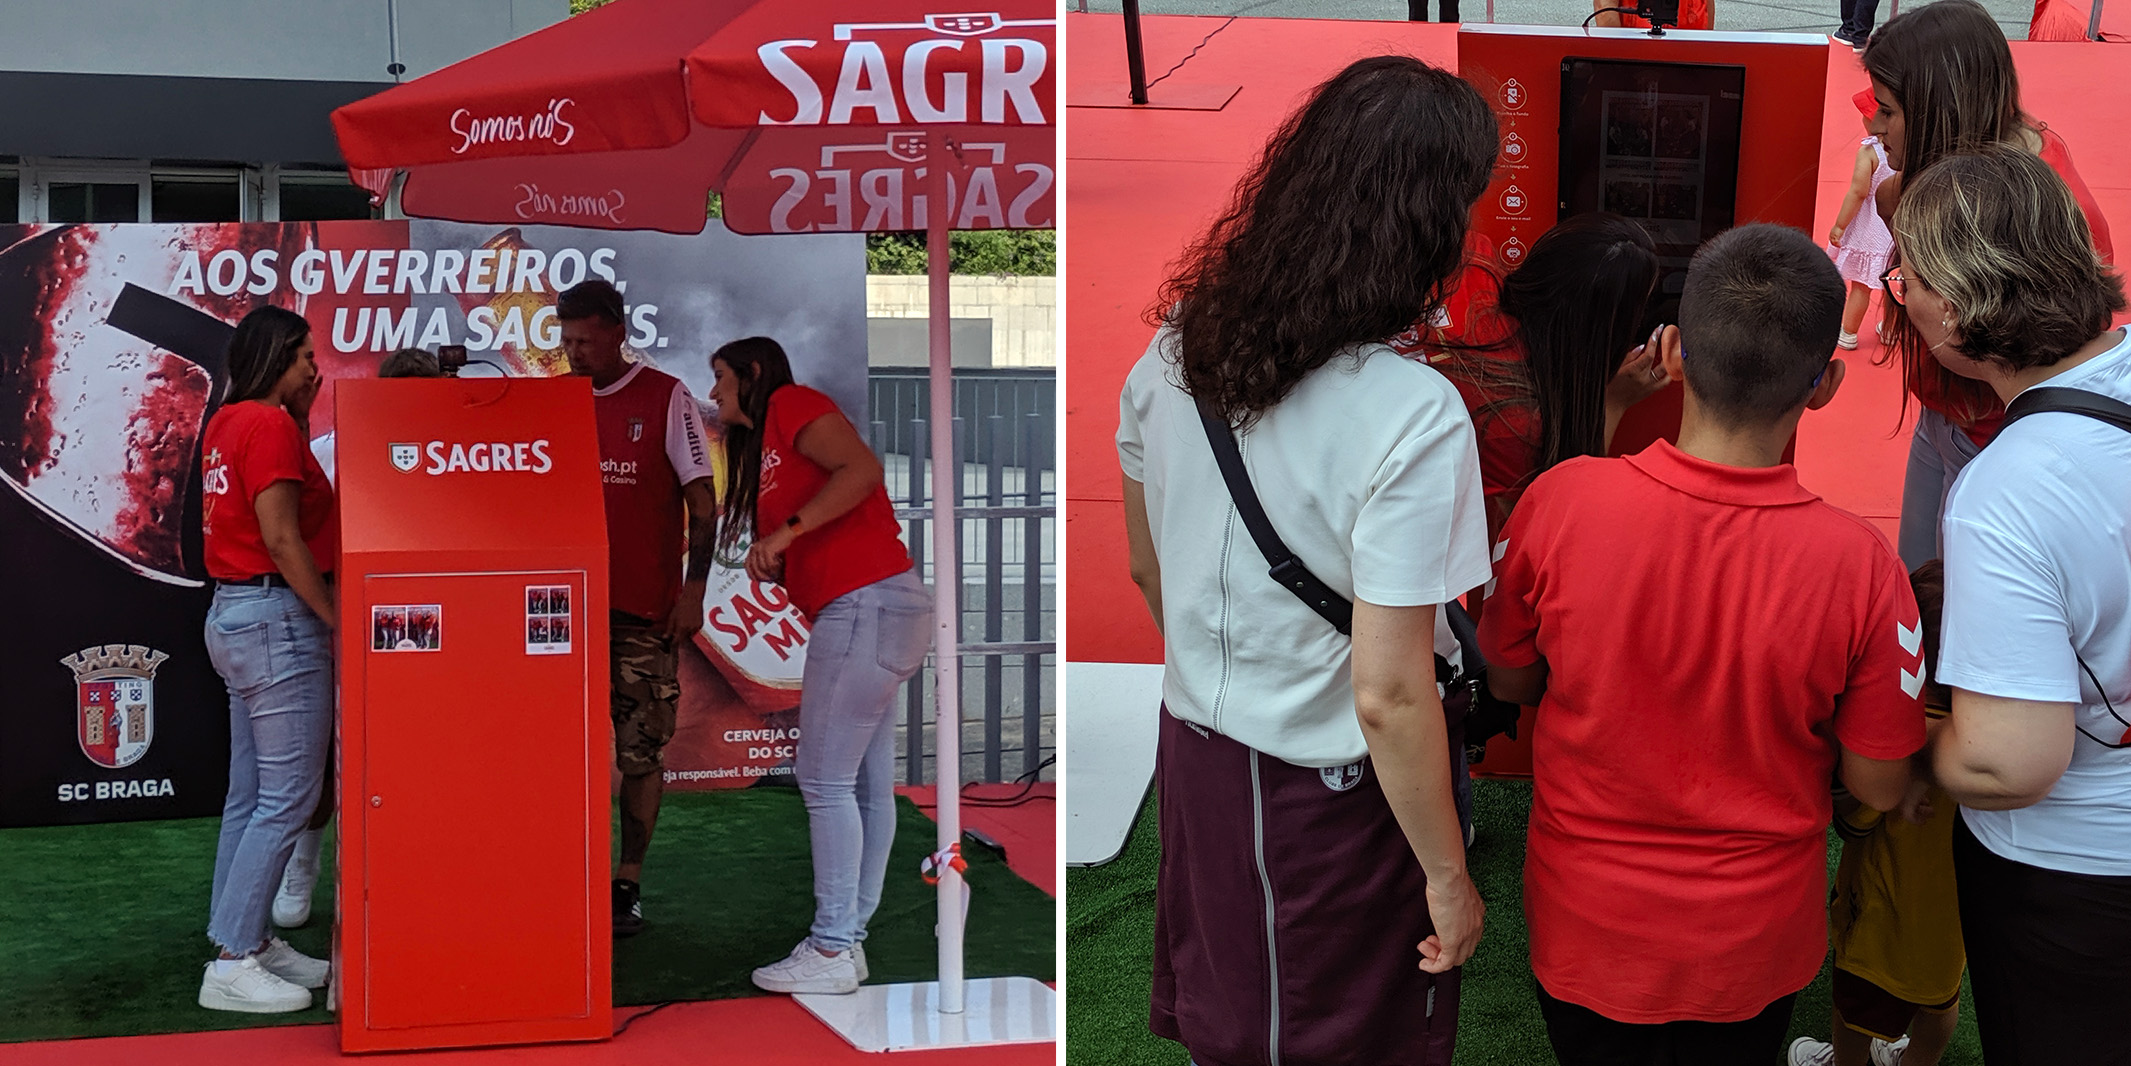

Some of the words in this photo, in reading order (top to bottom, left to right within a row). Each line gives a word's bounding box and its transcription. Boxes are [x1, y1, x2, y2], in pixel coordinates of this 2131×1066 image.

[757, 39, 1047, 125] SAGR
[450, 108, 525, 154] Somos
[166, 249, 279, 296] AOS
[331, 307, 451, 353] UMA
[464, 303, 669, 351] SAGS.
[426, 439, 552, 476] SAGRES
[600, 458, 638, 475] sh.pt
[610, 475, 637, 485] Casino
[708, 580, 789, 653] SAG
[723, 729, 786, 744] CERVEJA
[748, 746, 772, 759] DO
[774, 745, 793, 758] SC
[679, 766, 741, 782] responsável.
[743, 765, 768, 778] Beba
[769, 766, 791, 776] com
[58, 783, 90, 802] SC
[95, 778, 175, 800] BRAGA
